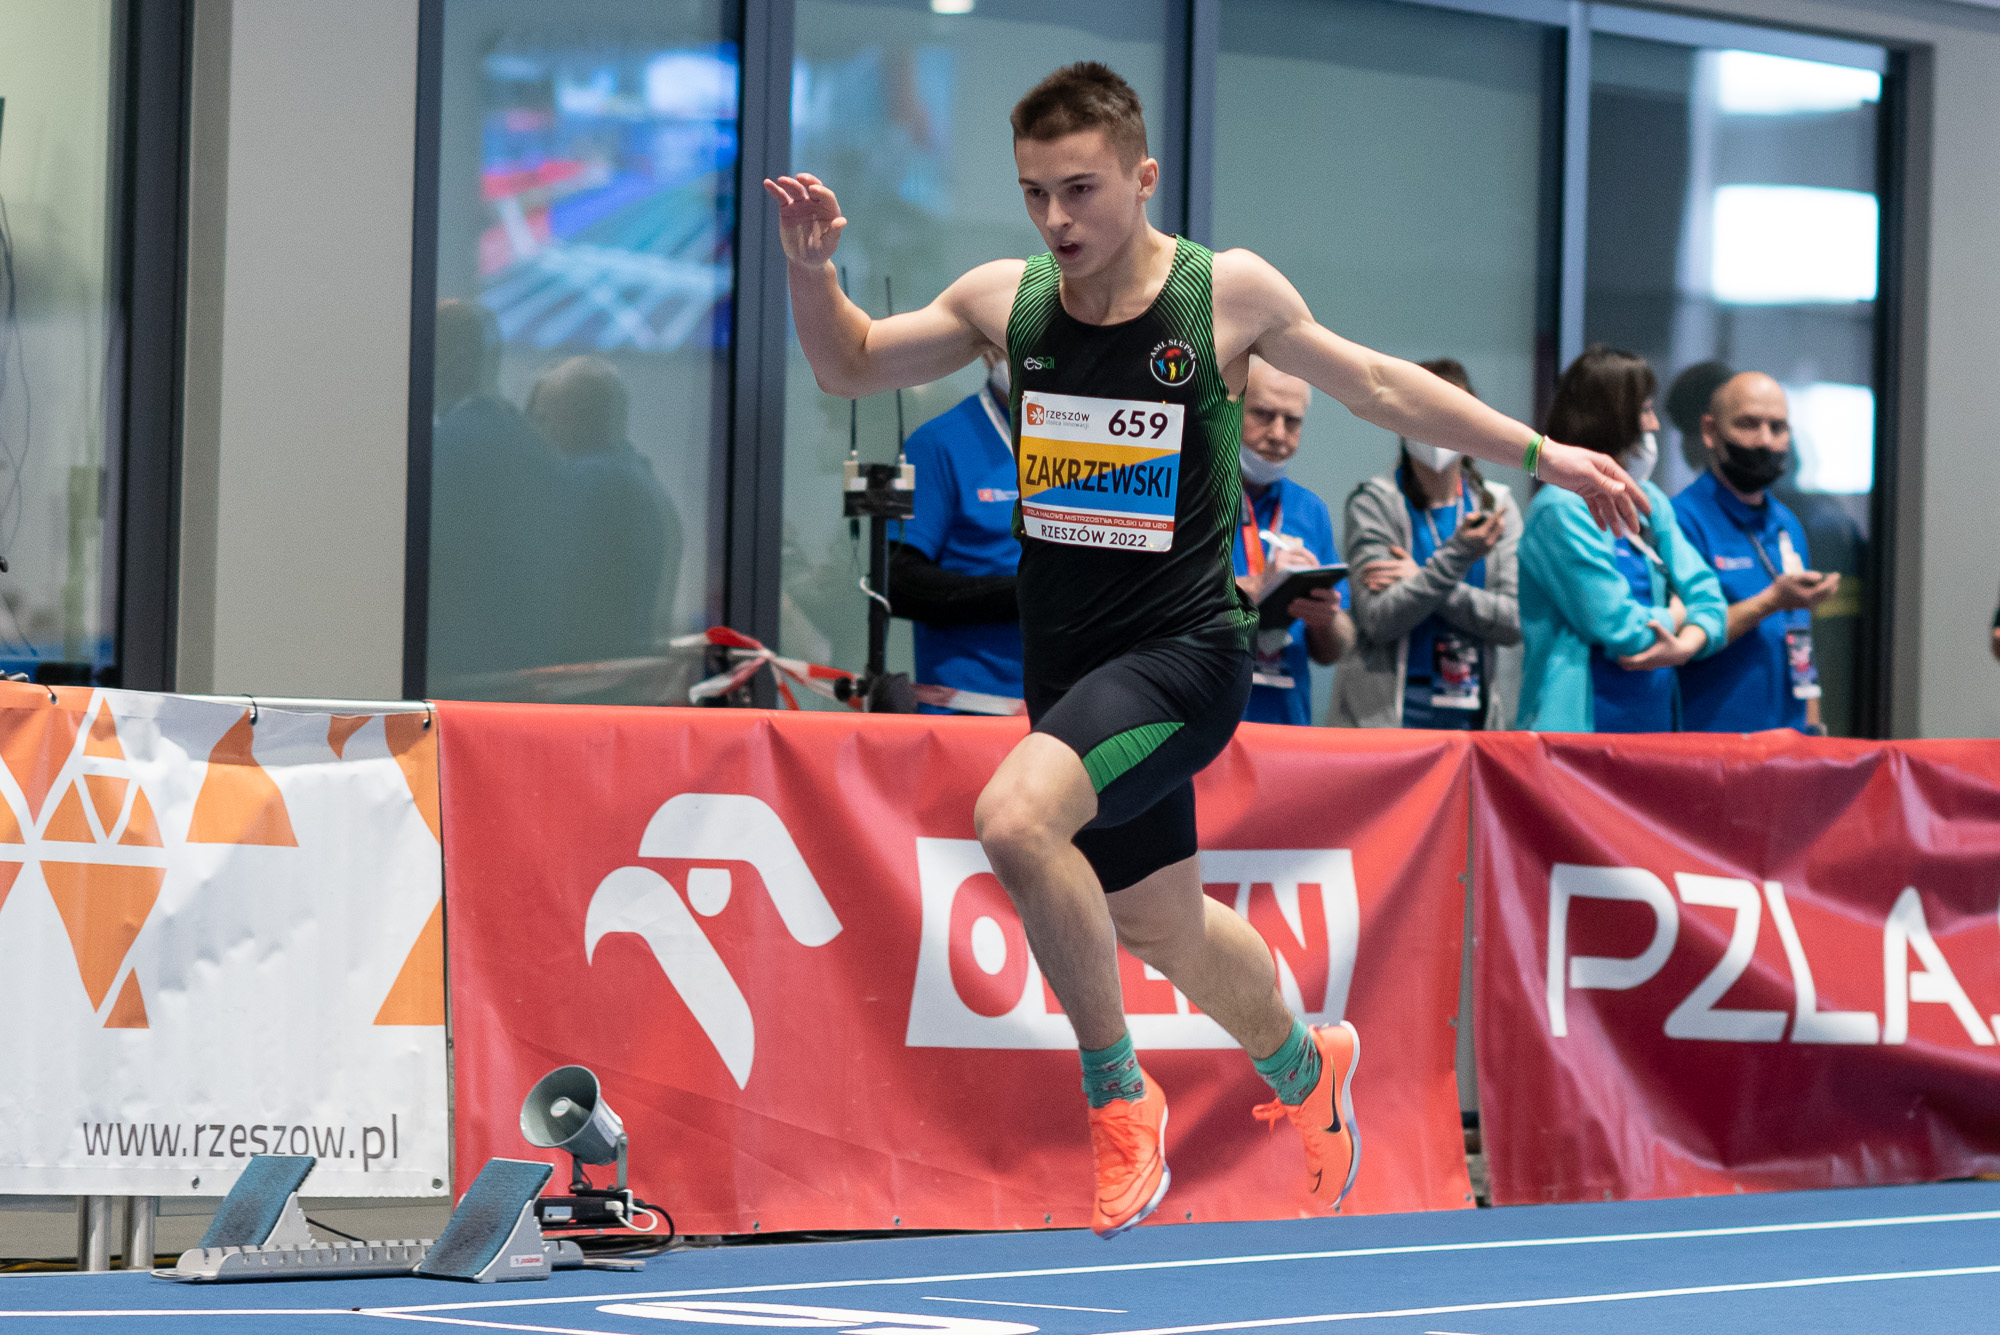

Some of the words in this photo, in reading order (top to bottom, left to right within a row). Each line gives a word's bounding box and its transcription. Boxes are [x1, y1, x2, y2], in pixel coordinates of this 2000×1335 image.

[1150, 341, 1168, 359] AML
[1045, 409, 1091, 423] rzeszów
[1108, 408, 1169, 440] 659
[1025, 453, 1173, 499] ZAKRZEWSKI
[1040, 511, 1064, 521] HALOWE
[1064, 513, 1113, 525] MISTRZOSTWA
[1113, 518, 1137, 528] POLSKI
[1152, 522, 1168, 530] U20
[1041, 524, 1106, 544] RZESZÓW
[1109, 531, 1148, 548] 2022
[1546, 862, 2000, 1046] PZLA
[83, 1113, 398, 1173] www.rzeszow.pl
